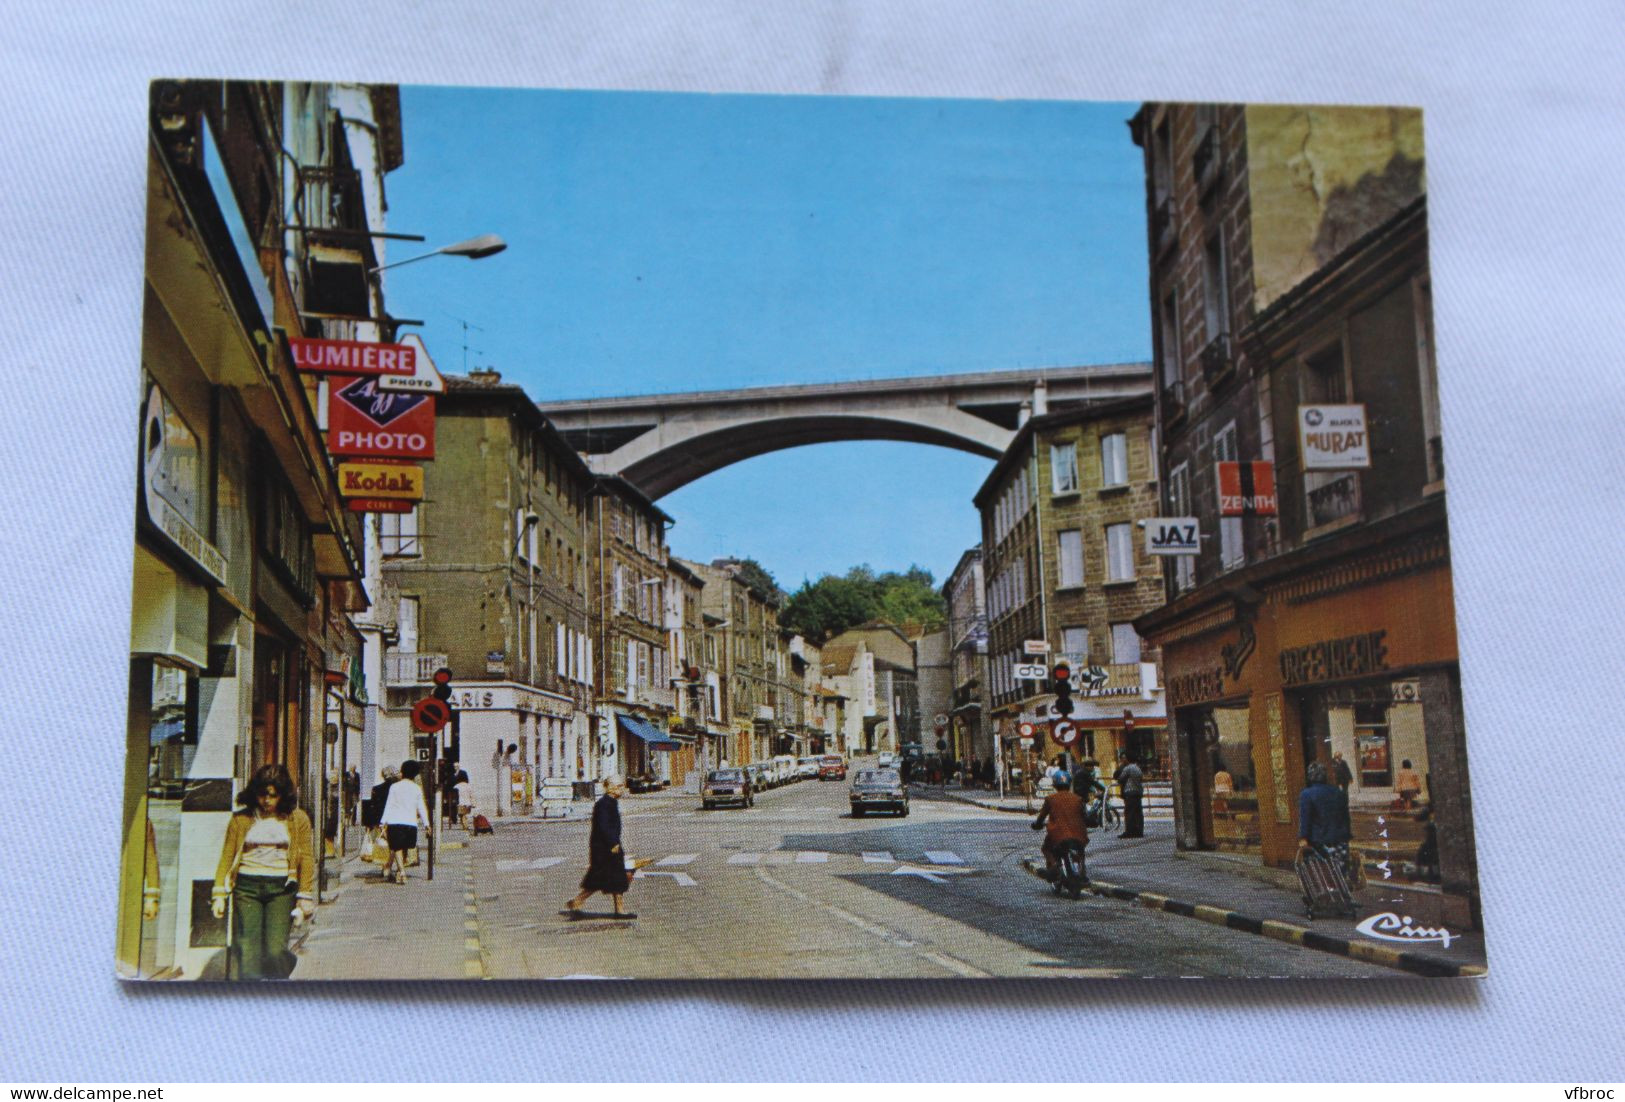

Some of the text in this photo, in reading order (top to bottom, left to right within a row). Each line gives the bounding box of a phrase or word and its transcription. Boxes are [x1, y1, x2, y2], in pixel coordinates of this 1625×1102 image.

[291, 342, 413, 370] LUMIÈRE
[389, 378, 433, 387] PHOTO
[348, 380, 411, 415] Agf
[338, 431, 426, 450] PHOTO
[1306, 431, 1365, 454] MURAT
[344, 470, 414, 492] Kodak
[1223, 495, 1274, 509] ZENITH
[1151, 525, 1197, 544] JAZ
[450, 691, 494, 708] ARIS
